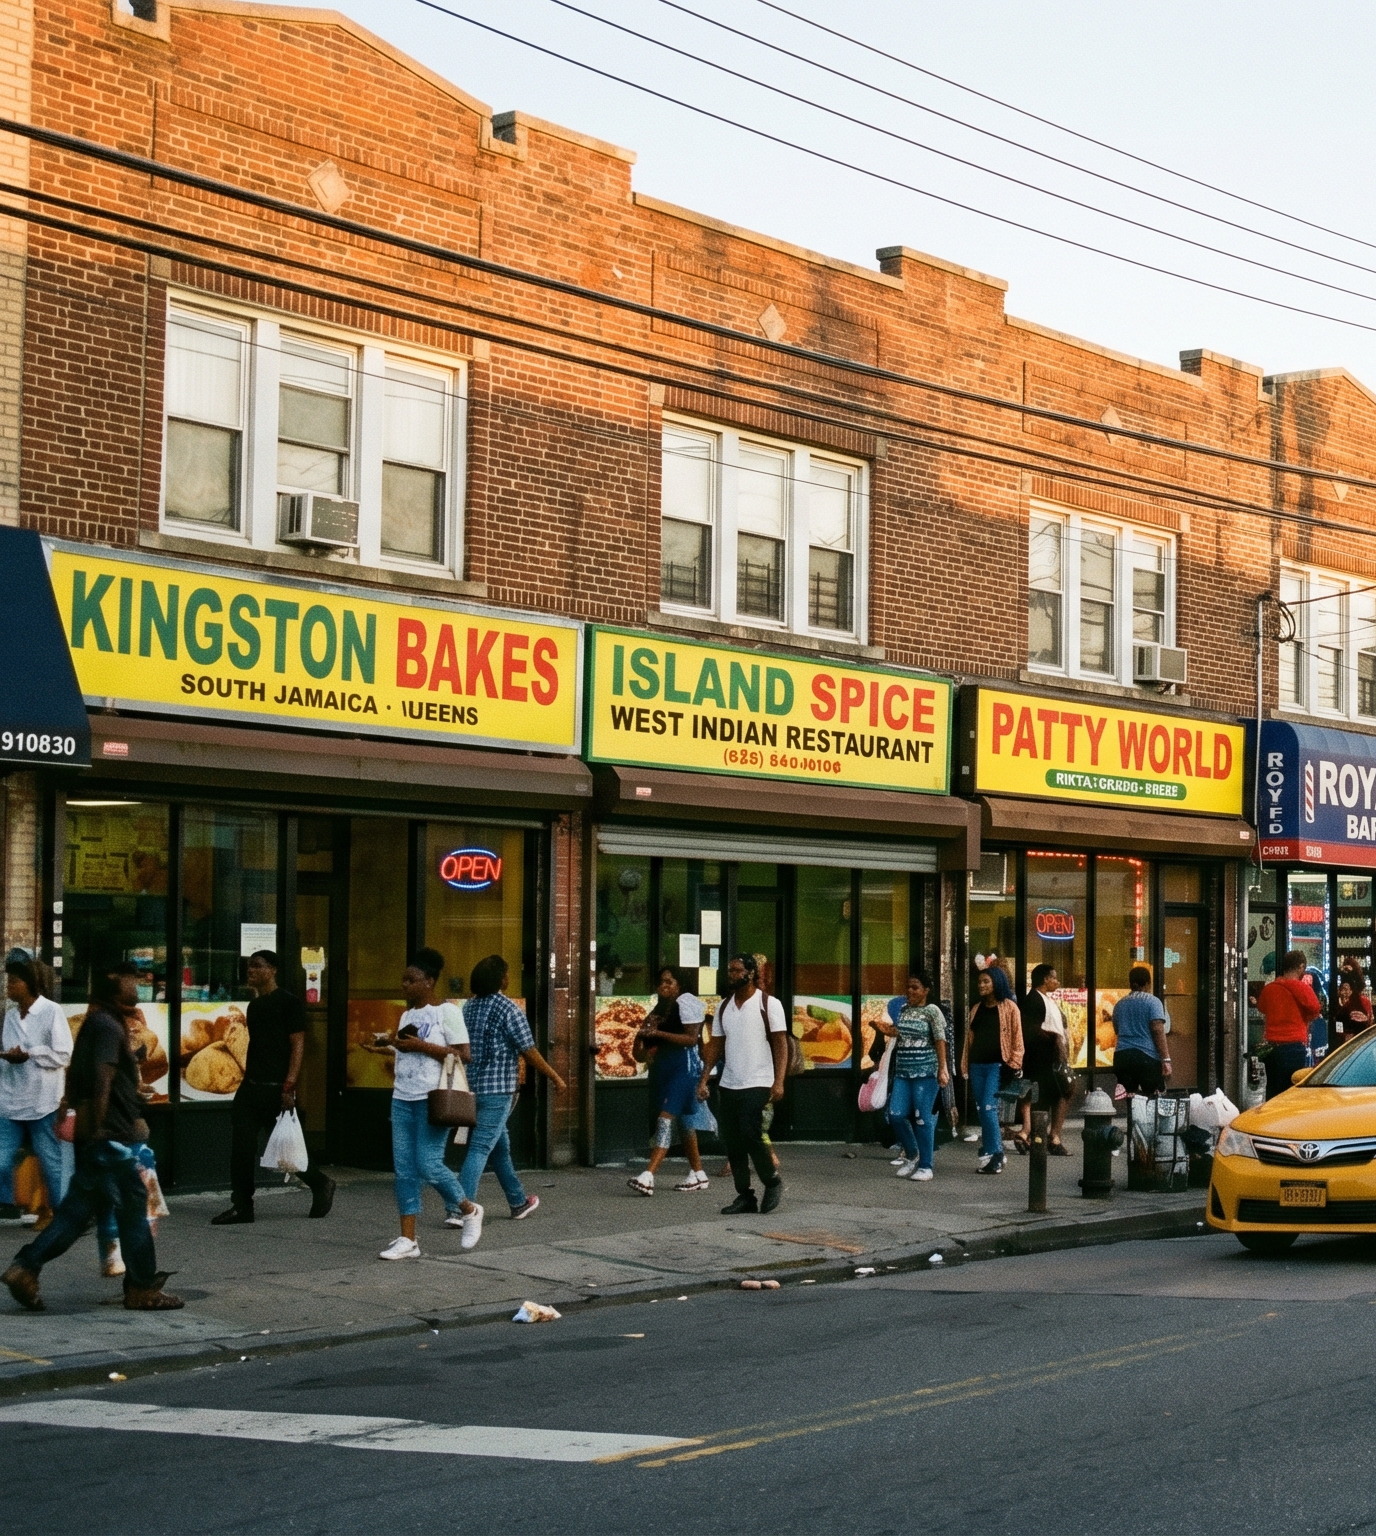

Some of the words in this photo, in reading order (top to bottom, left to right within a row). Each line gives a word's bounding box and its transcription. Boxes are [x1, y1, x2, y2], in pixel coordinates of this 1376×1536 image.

[71, 569, 377, 685] KINGSTON
[396, 617, 559, 706] BAKES
[181, 673, 265, 702] SOUTH
[274, 685, 378, 715] JAMAICA
[402, 700, 479, 726] UEENS
[612, 644, 795, 716] ISLAND
[810, 673, 936, 734] SPICE
[1, 731, 76, 756] 910830
[611, 705, 684, 737] WEST
[692, 714, 778, 747] INDIAN
[786, 726, 934, 764] RESTAURANT
[992, 702, 1108, 766] PATTY
[1117, 719, 1233, 781] WORLD
[440, 856, 502, 880] OPEN
